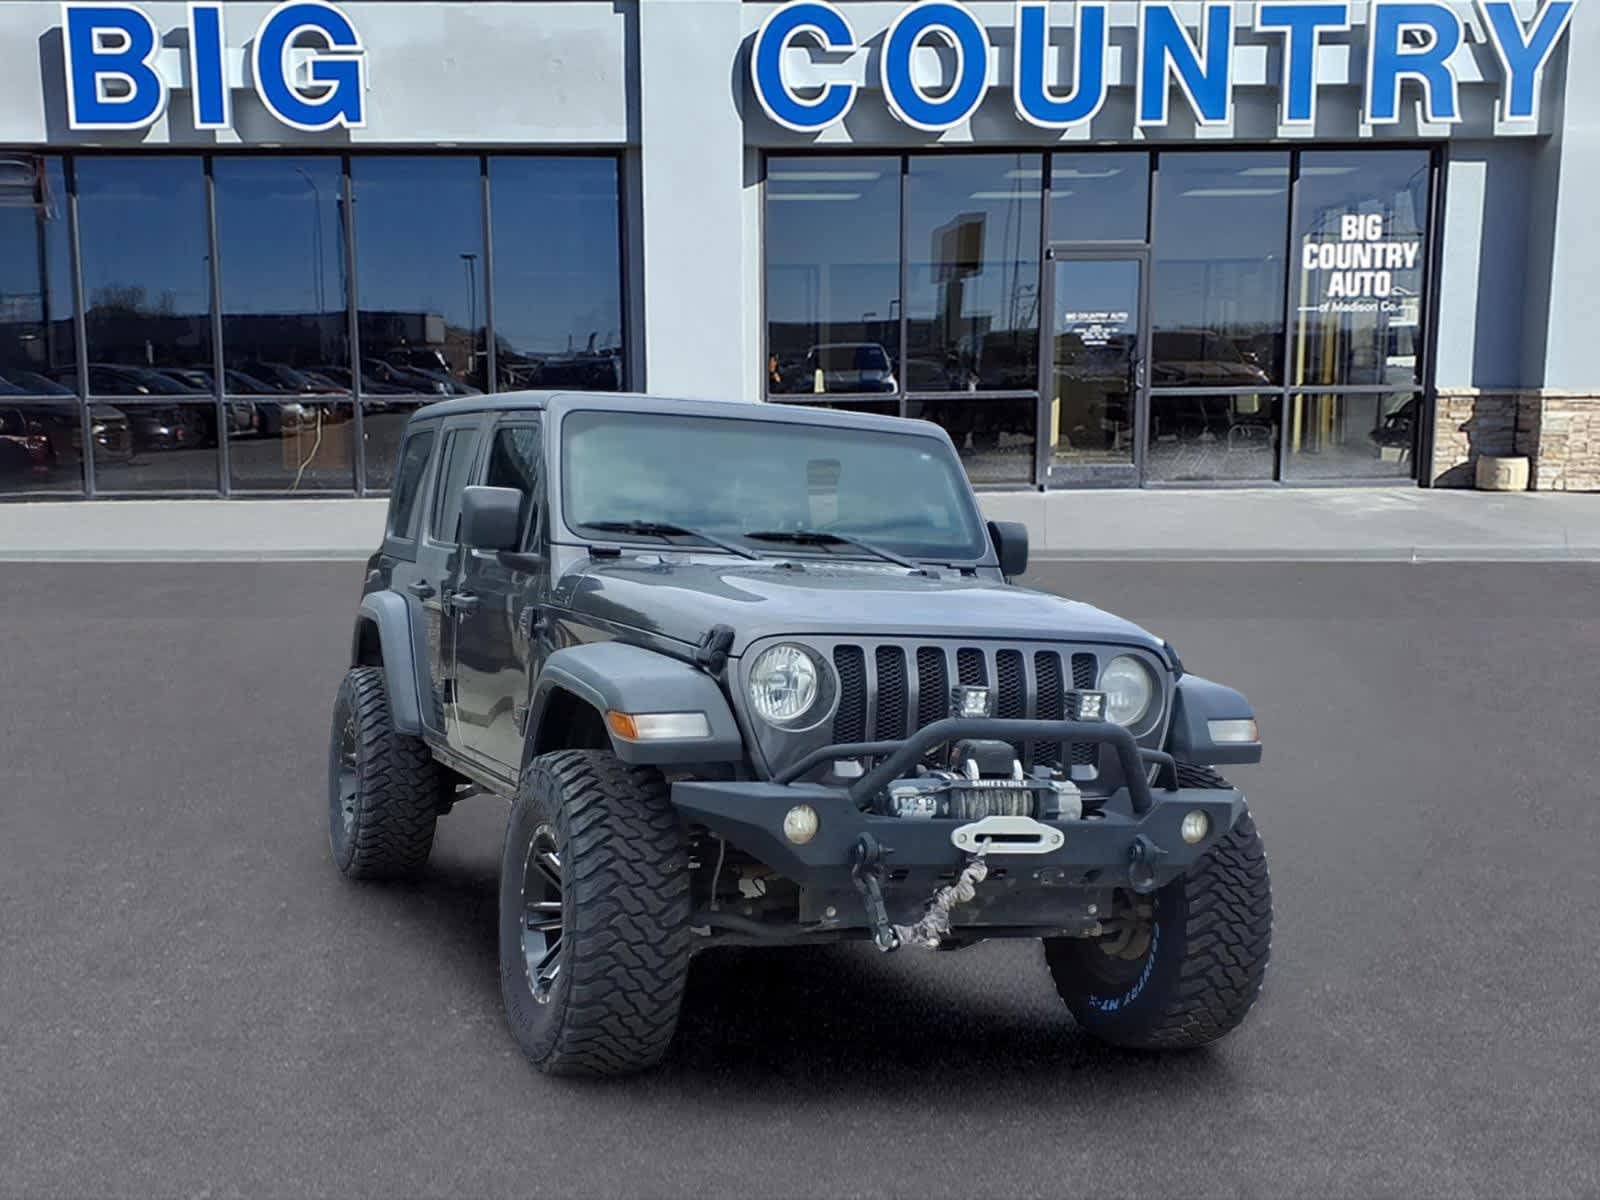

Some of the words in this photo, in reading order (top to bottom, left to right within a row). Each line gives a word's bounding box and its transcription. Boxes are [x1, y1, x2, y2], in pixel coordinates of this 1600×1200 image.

[62, 1, 366, 131] BIG
[751, 0, 1575, 133] COUNTRY
[1341, 213, 1383, 241] BIG
[1302, 242, 1419, 270] COUNTRY
[1327, 271, 1391, 297] AUTO
[1319, 301, 1330, 312] of
[1331, 301, 1378, 312] Madison
